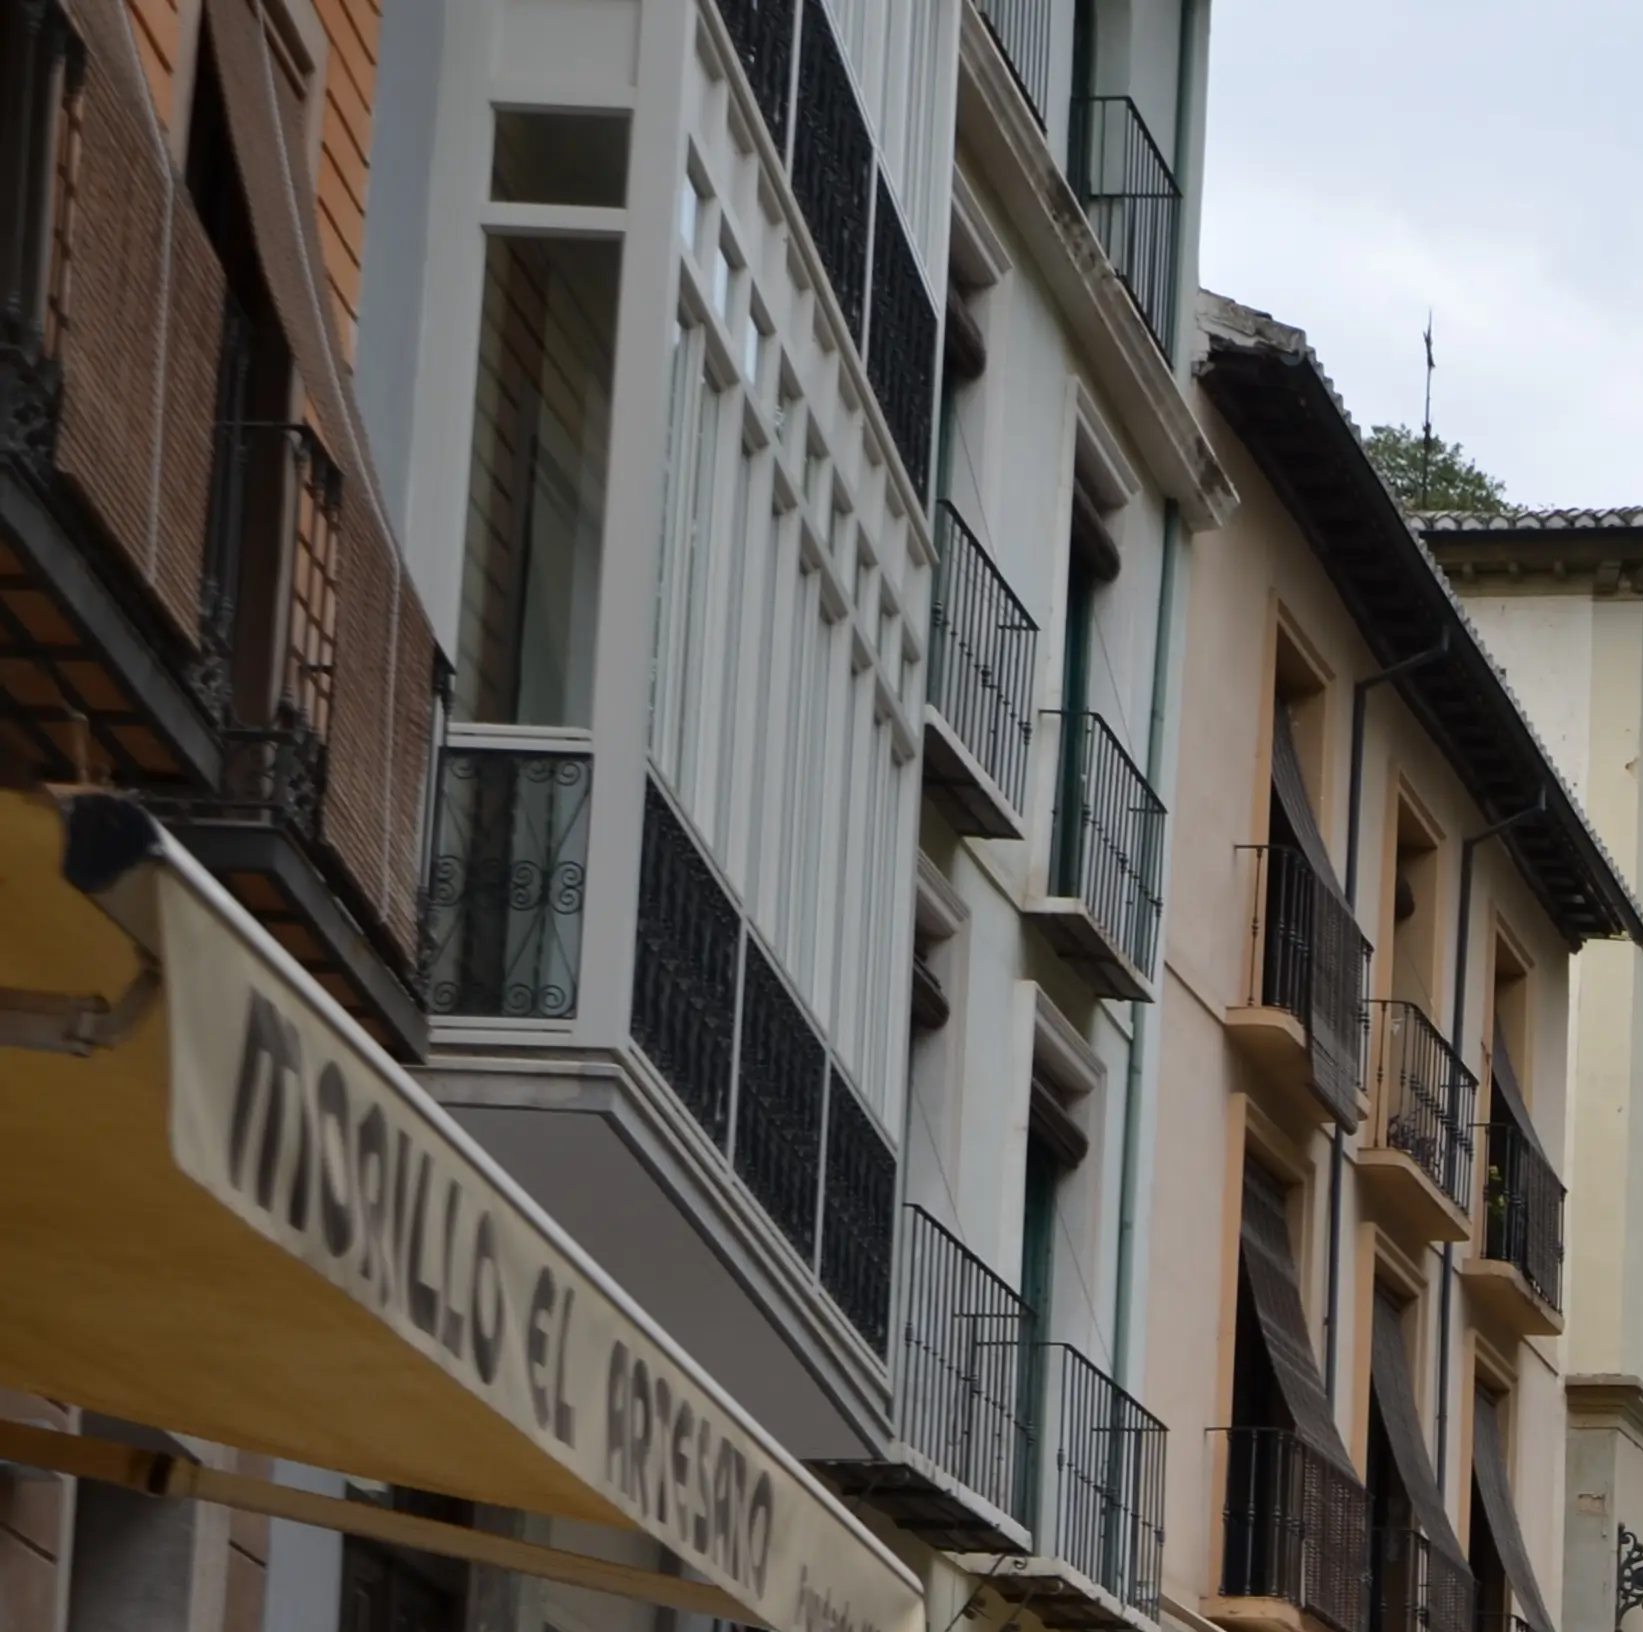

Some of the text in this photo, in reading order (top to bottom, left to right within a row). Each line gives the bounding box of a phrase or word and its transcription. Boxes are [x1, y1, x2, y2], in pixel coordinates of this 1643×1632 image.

[228, 989, 775, 1601] MORILLO EL ARTESANO
